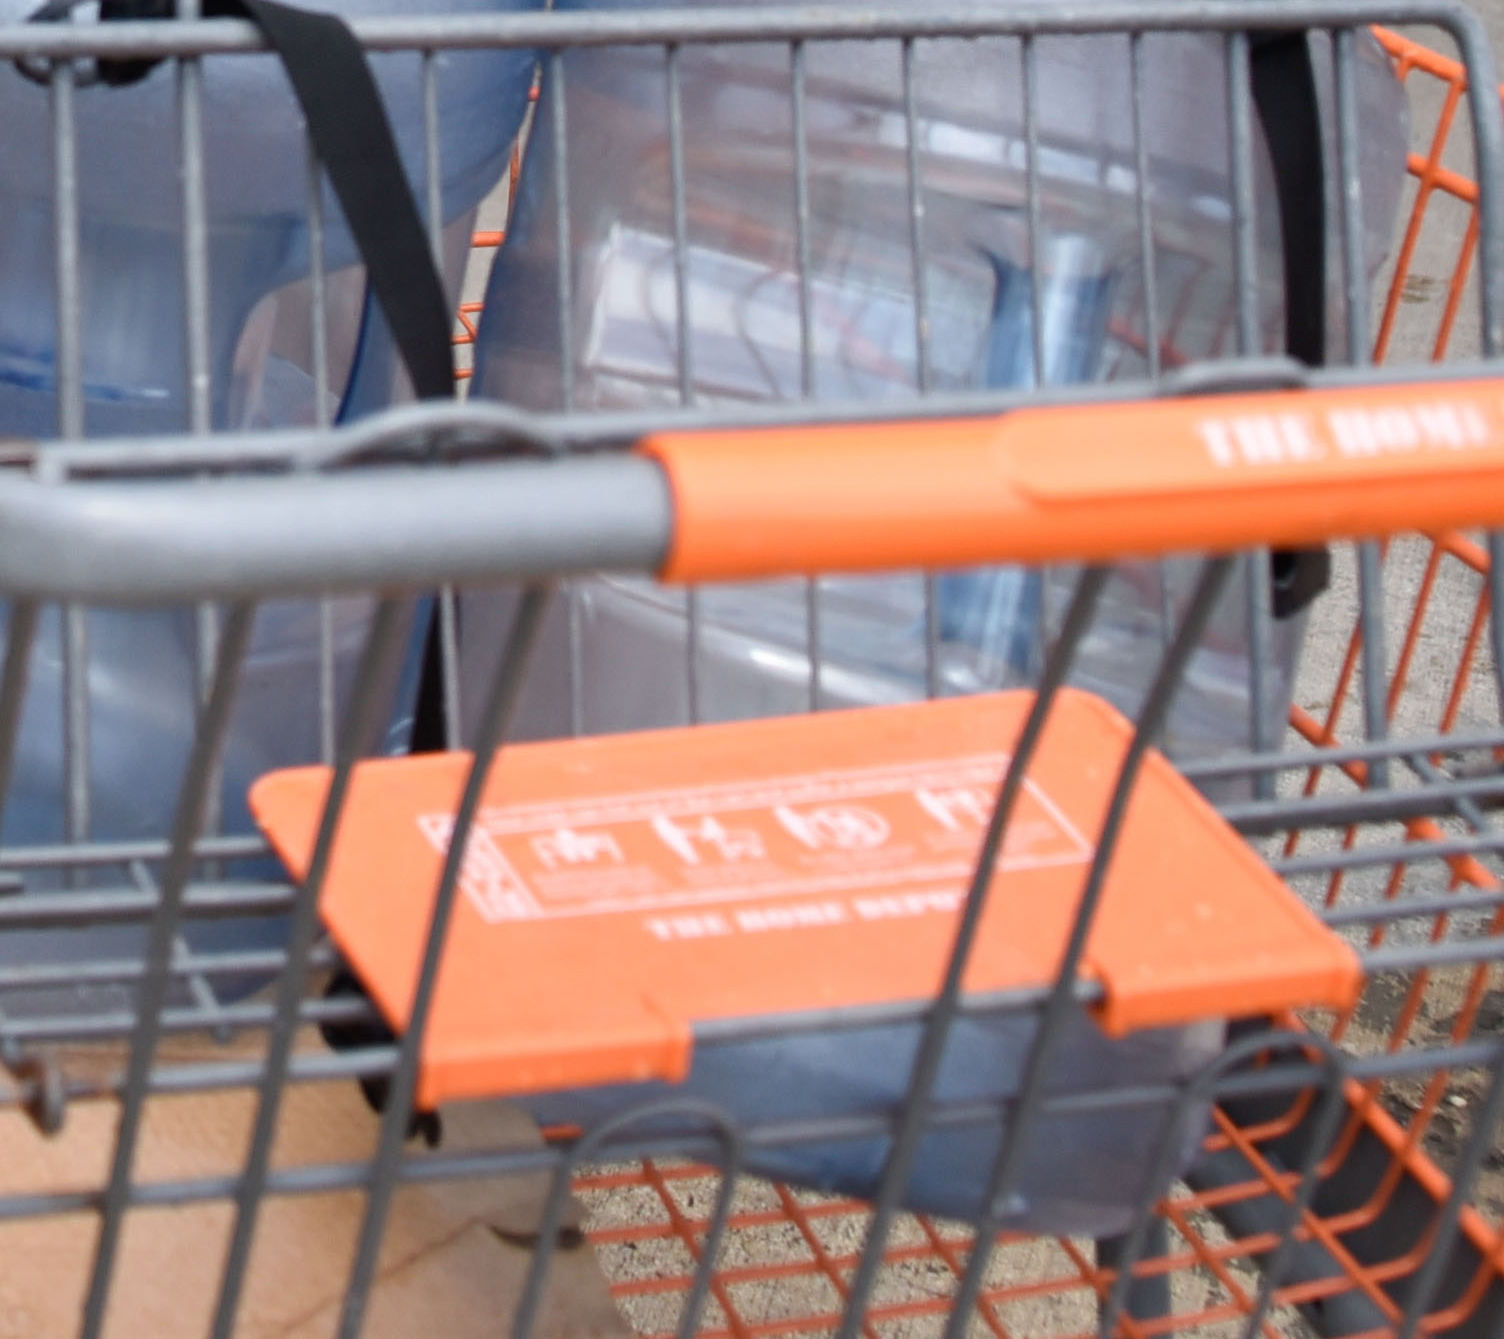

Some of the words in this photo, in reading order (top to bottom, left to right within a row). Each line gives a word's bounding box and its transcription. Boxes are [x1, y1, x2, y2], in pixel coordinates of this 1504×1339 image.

[1200, 413, 1324, 467] THE
[1325, 401, 1494, 459] HOME
[642, 913, 733, 941] THE
[734, 902, 849, 935] HOME
